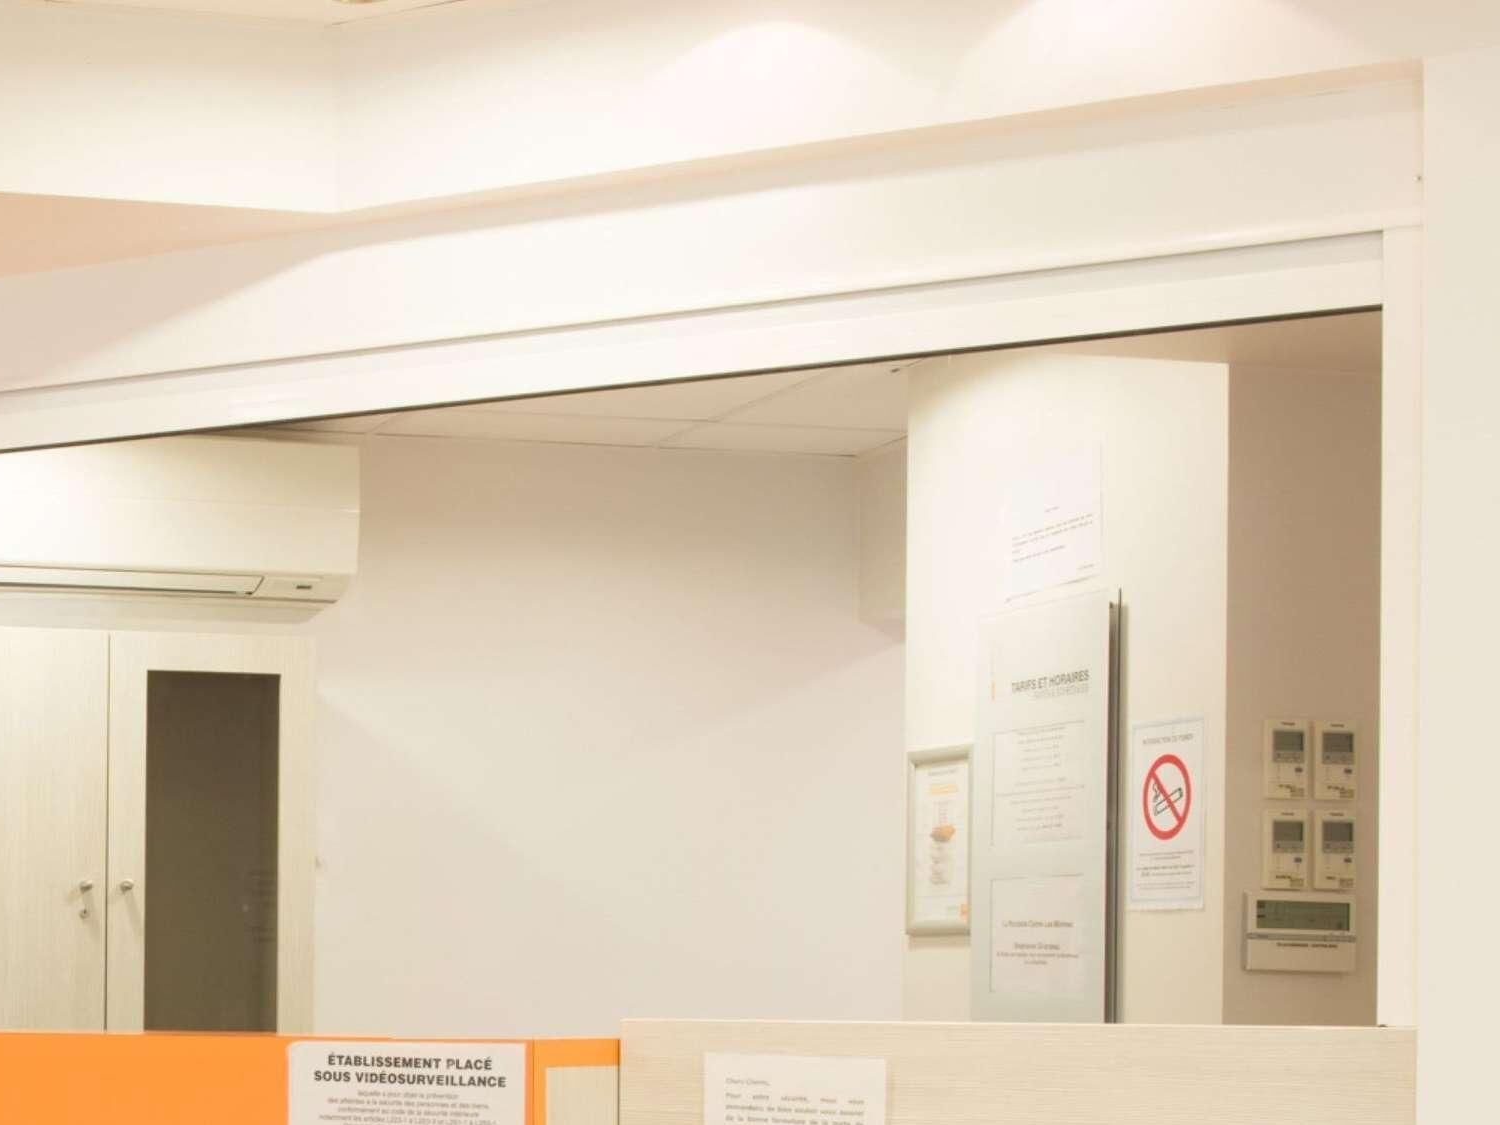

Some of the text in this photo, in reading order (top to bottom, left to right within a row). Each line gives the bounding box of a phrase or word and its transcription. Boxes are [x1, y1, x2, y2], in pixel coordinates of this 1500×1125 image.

[1037, 676, 1048, 689] ET
[1049, 669, 1090, 688] HORAIRES
[328, 1052, 493, 1071] ÉTABLISSEMENT PLACÉ
[314, 1070, 507, 1088] SOUS VIDÉOSURVEILLANCE
